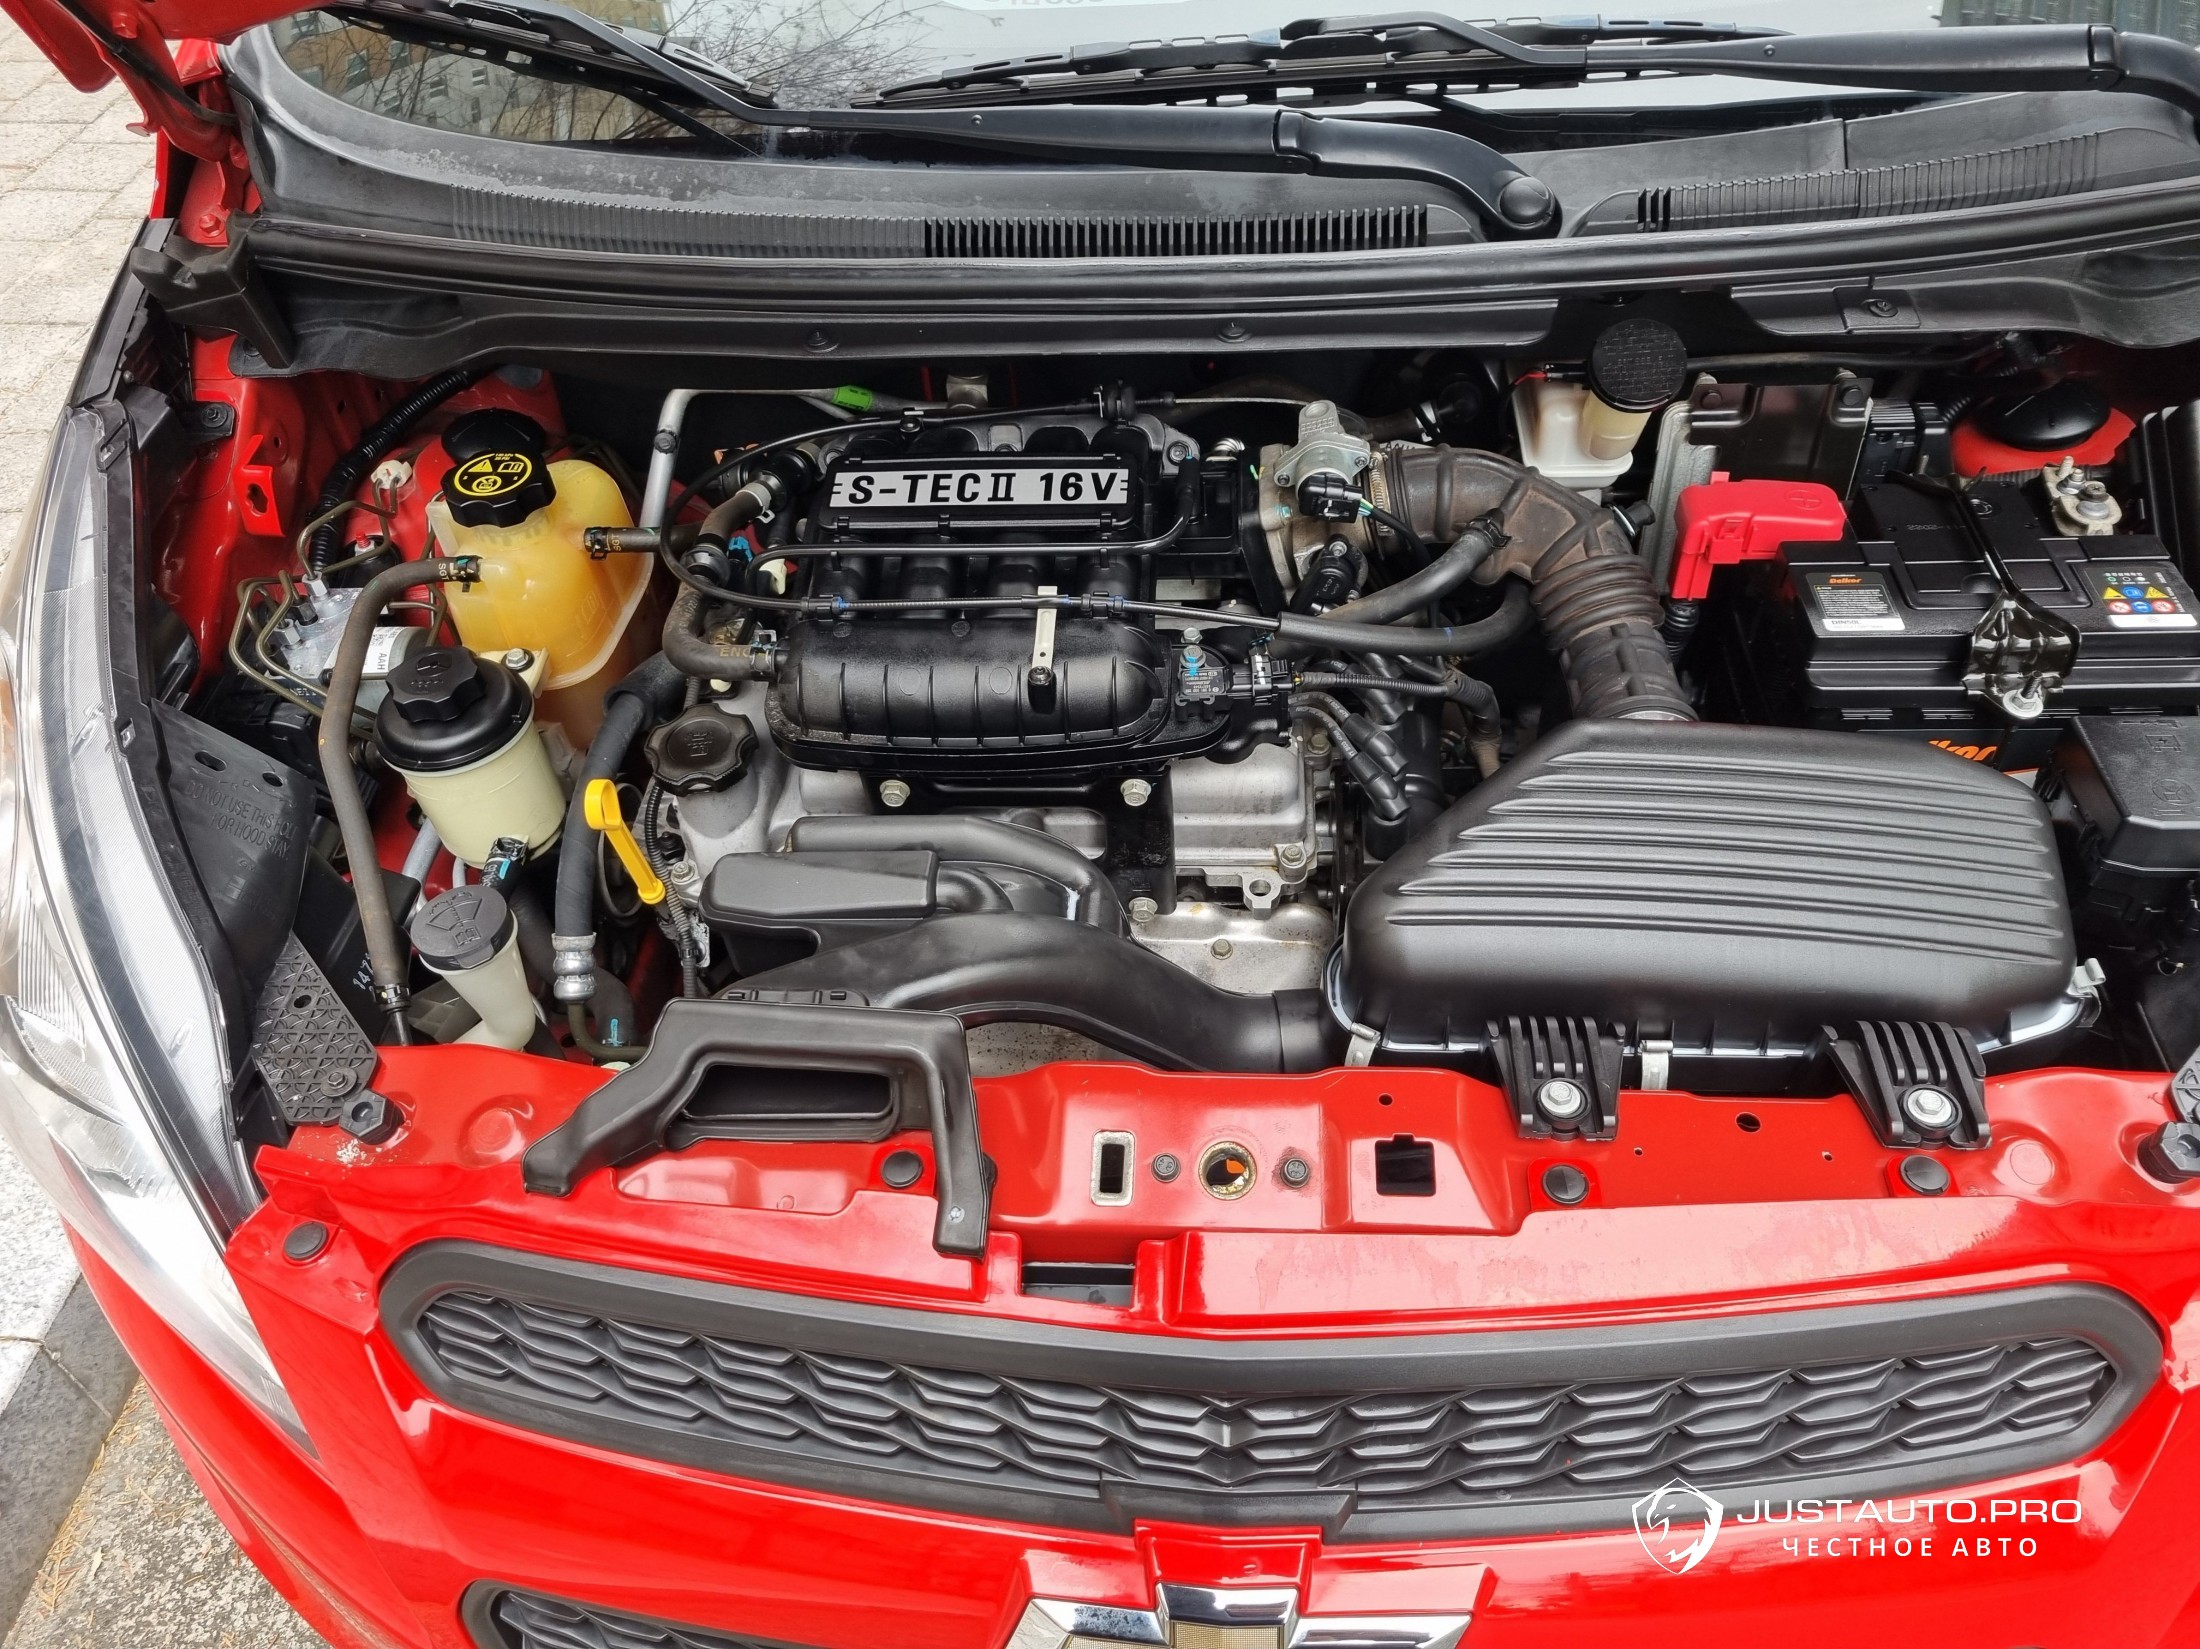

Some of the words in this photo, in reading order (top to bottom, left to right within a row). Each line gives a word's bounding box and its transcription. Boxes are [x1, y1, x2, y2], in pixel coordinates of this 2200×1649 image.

[1039, 472, 1118, 502] 16V
[438, 562, 450, 581] SGT
[376, 652, 388, 670] AAH
[206, 788, 227, 809] NOT
[226, 797, 252, 819] USE
[250, 806, 275, 829] THIS
[211, 812, 235, 835] FOR
[234, 822, 267, 846] HOOD
